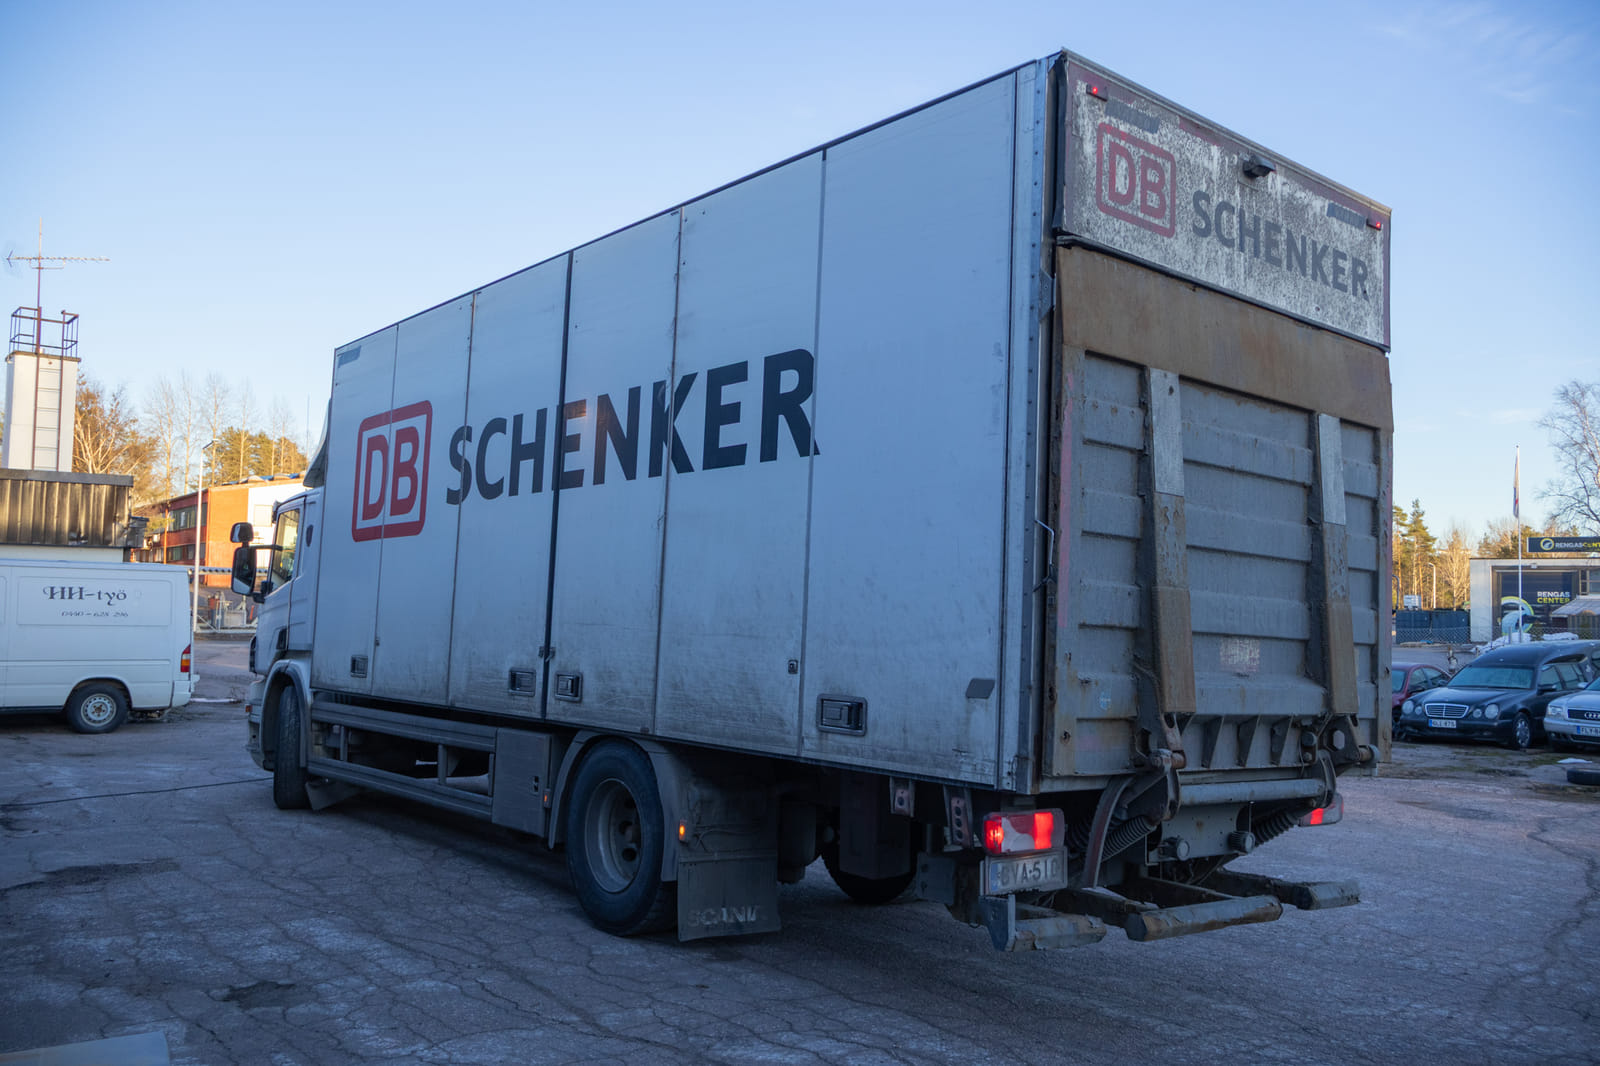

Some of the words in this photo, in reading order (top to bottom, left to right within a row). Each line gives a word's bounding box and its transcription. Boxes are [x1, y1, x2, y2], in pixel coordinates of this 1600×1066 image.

[1108, 141, 1167, 220] DB
[1192, 190, 1369, 301] SCHENKER
[362, 426, 419, 520] DB
[446, 348, 820, 505] SCHENKER
